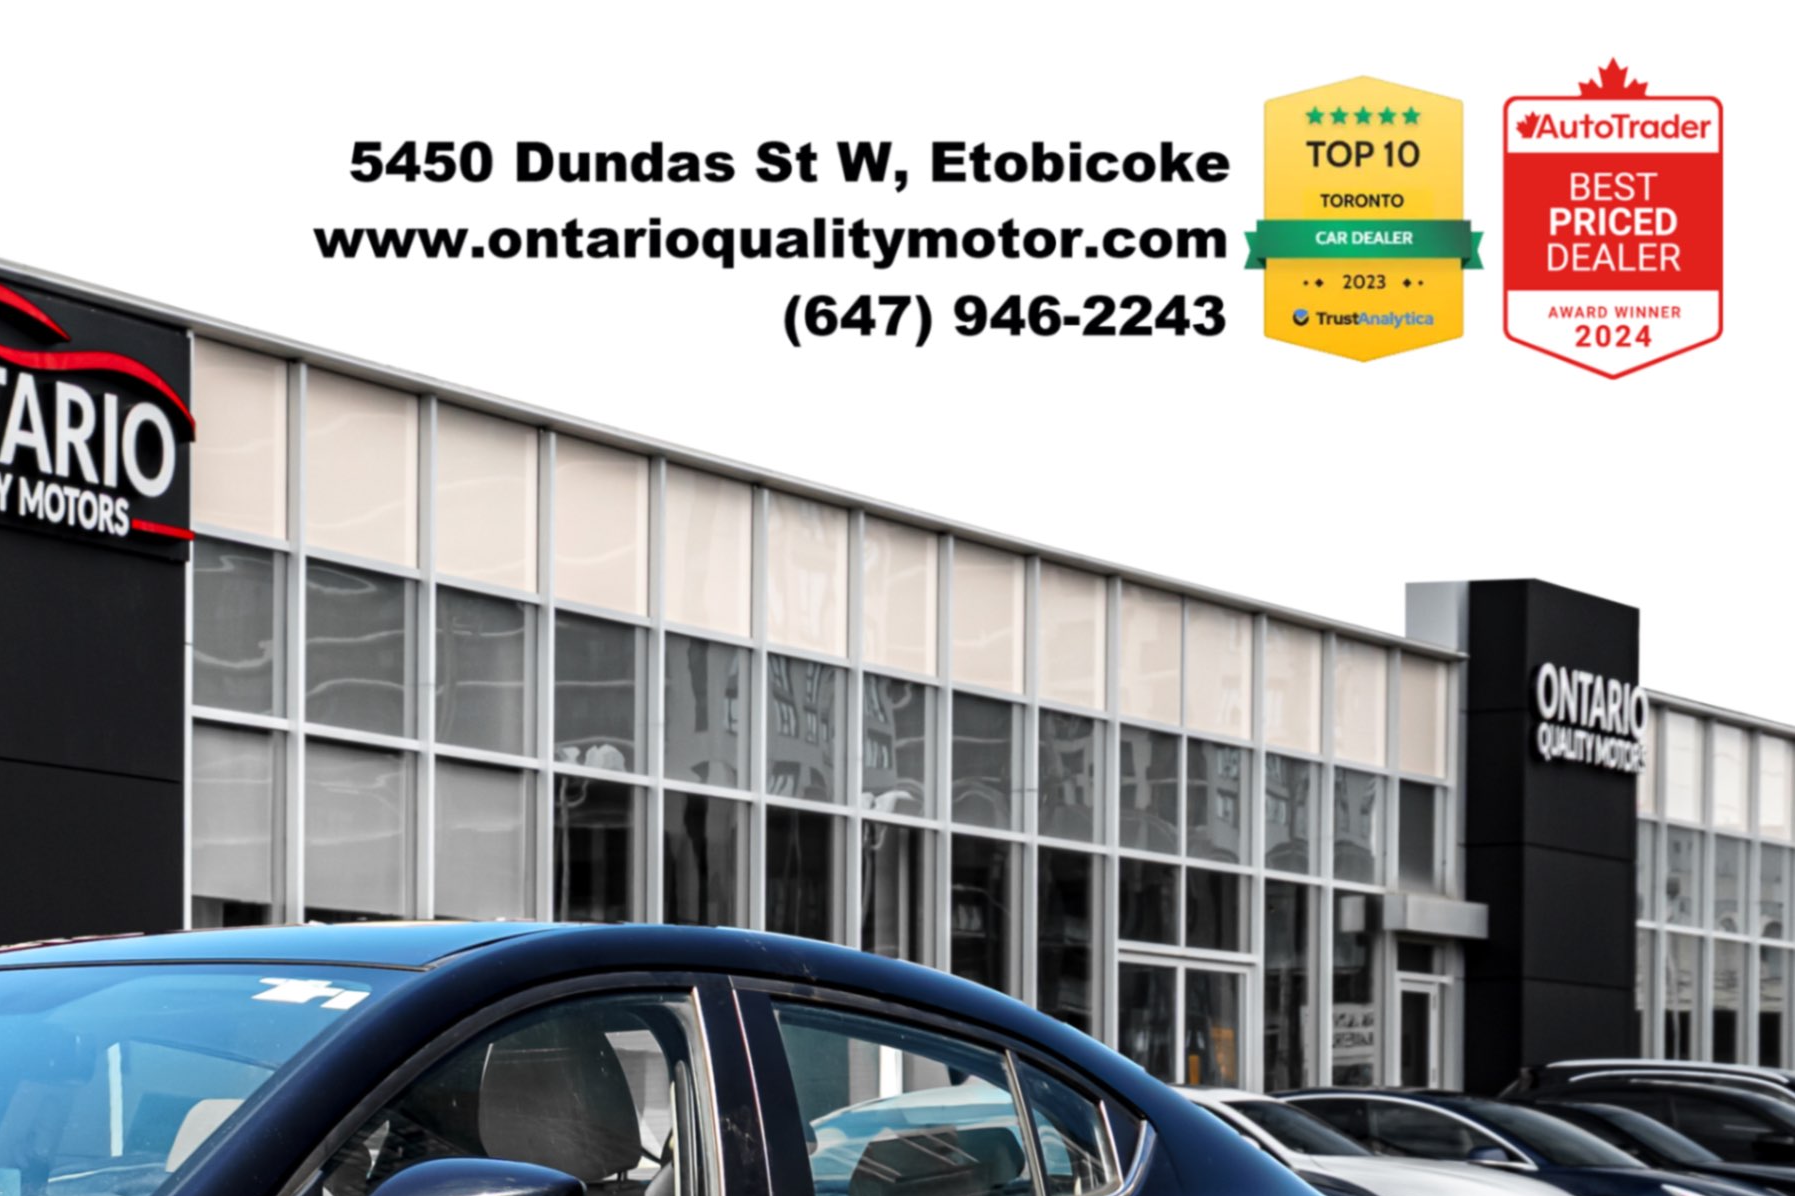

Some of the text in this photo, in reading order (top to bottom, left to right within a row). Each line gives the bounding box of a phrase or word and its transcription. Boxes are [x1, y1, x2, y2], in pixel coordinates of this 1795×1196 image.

[19, 476, 130, 537] MOTORS
[1537, 662, 1649, 741] ONTARIO
[1537, 722, 1646, 774] QUALITY MOTORS
